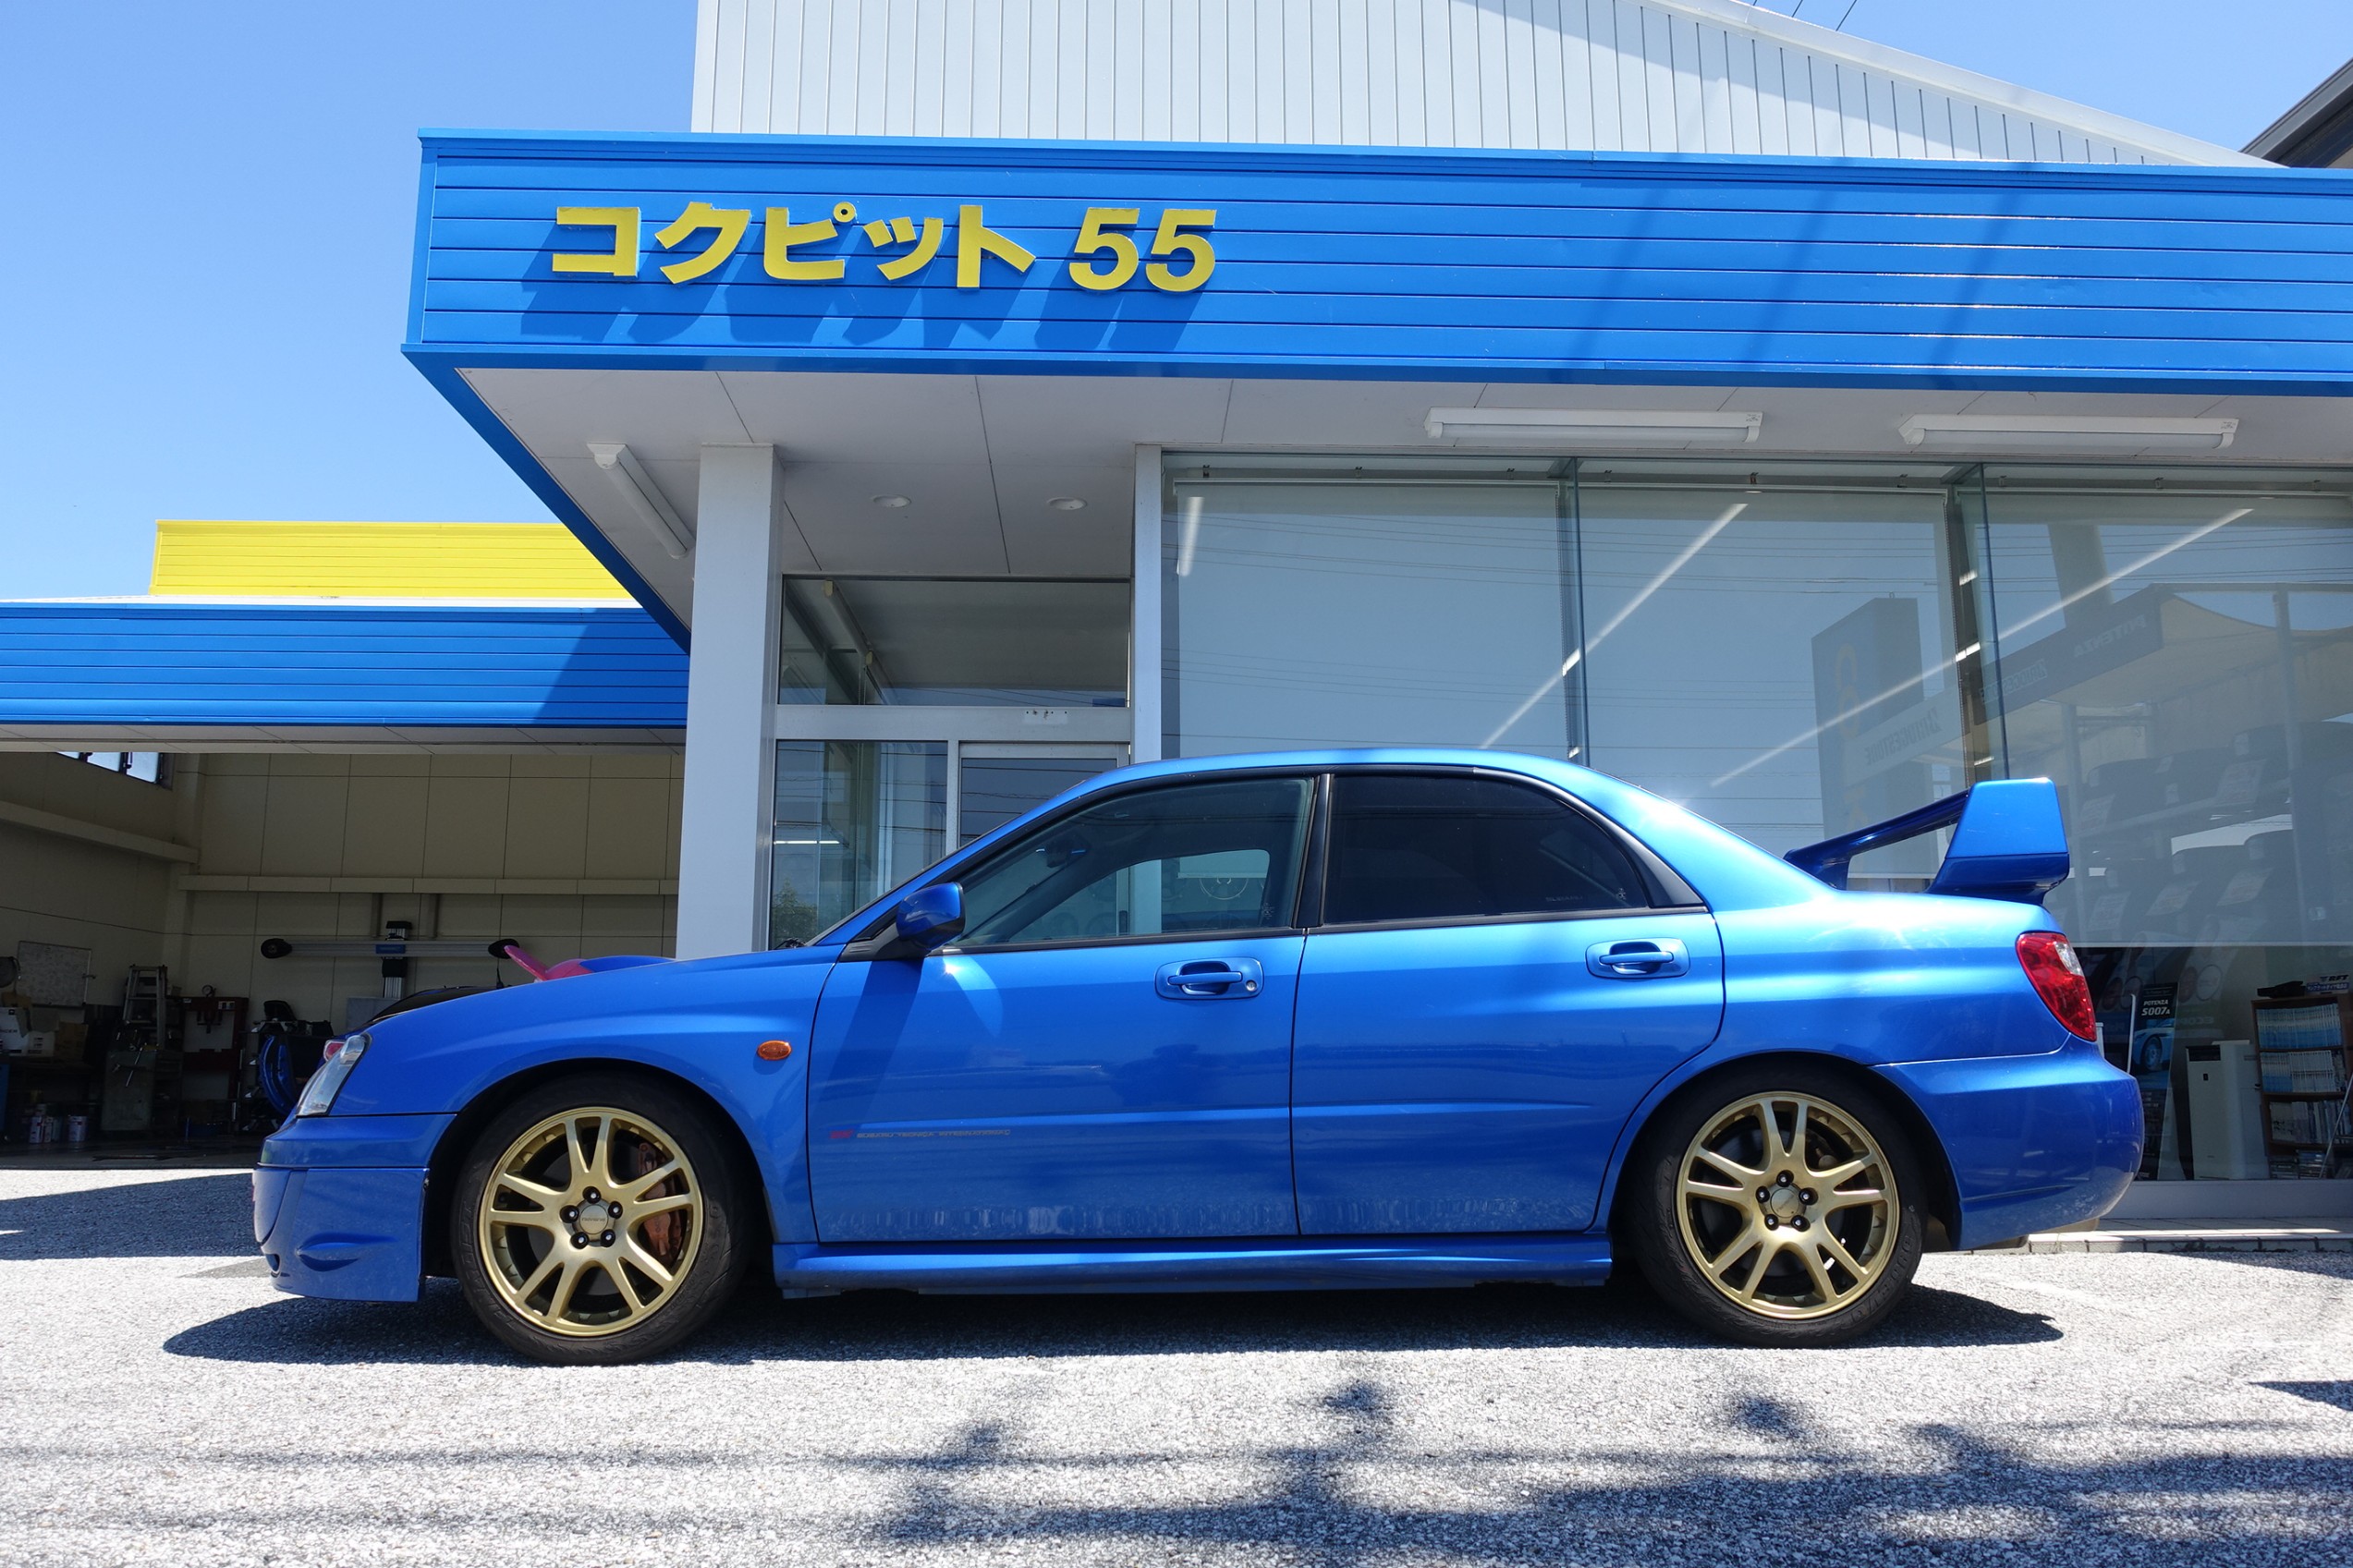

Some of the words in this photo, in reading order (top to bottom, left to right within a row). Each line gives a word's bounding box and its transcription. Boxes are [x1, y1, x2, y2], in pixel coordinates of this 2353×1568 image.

[552, 201, 1035, 288] コクピット
[1068, 207, 1216, 292] 55
